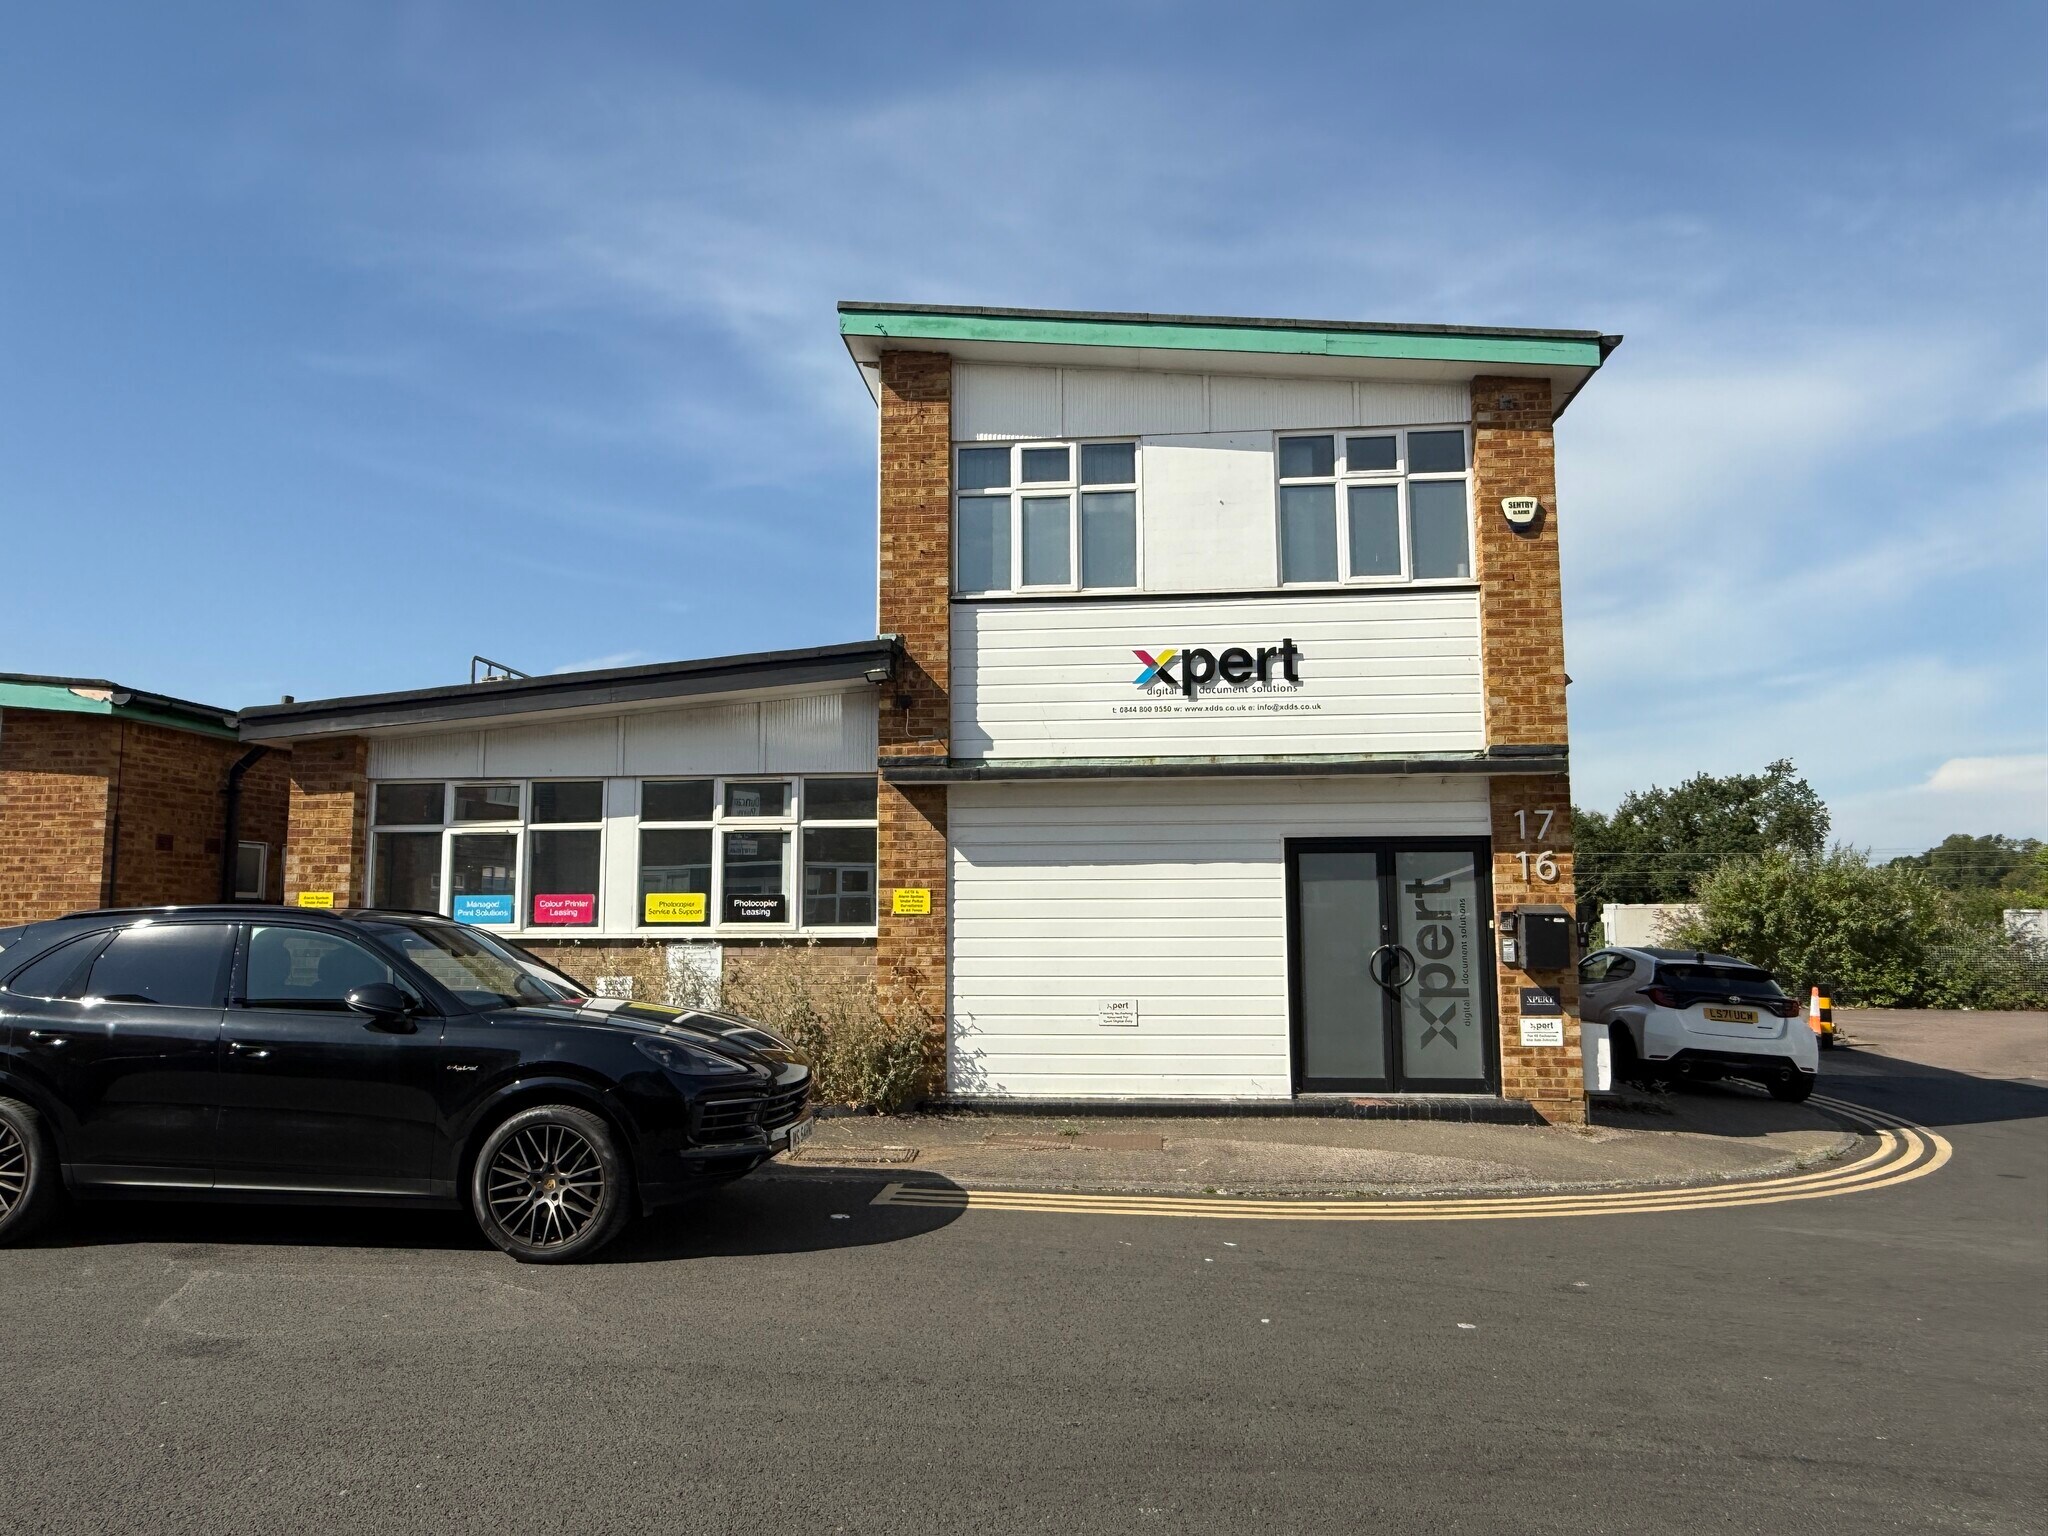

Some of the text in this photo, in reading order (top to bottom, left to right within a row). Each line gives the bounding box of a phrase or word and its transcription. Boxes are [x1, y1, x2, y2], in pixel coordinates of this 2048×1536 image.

[1508, 501, 1534, 509] SENTRY
[1132, 638, 1299, 696] xpert
[1146, 683, 1298, 698] digital document solutions
[1514, 809, 1554, 840] 17
[1515, 850, 1557, 882] 16
[466, 900, 499, 910] Managed
[539, 900, 589, 908] Colour Printer
[658, 901, 695, 909] Photocopier
[733, 899, 778, 909] Photocopier
[549, 908, 578, 917] Leasing
[678, 908, 703, 916] Support
[741, 908, 771, 917] Leasing
[1405, 878, 1470, 1050] xpert
[1459, 898, 1473, 1027] digital document solutions
[1526, 995, 1555, 1003] XPERT
